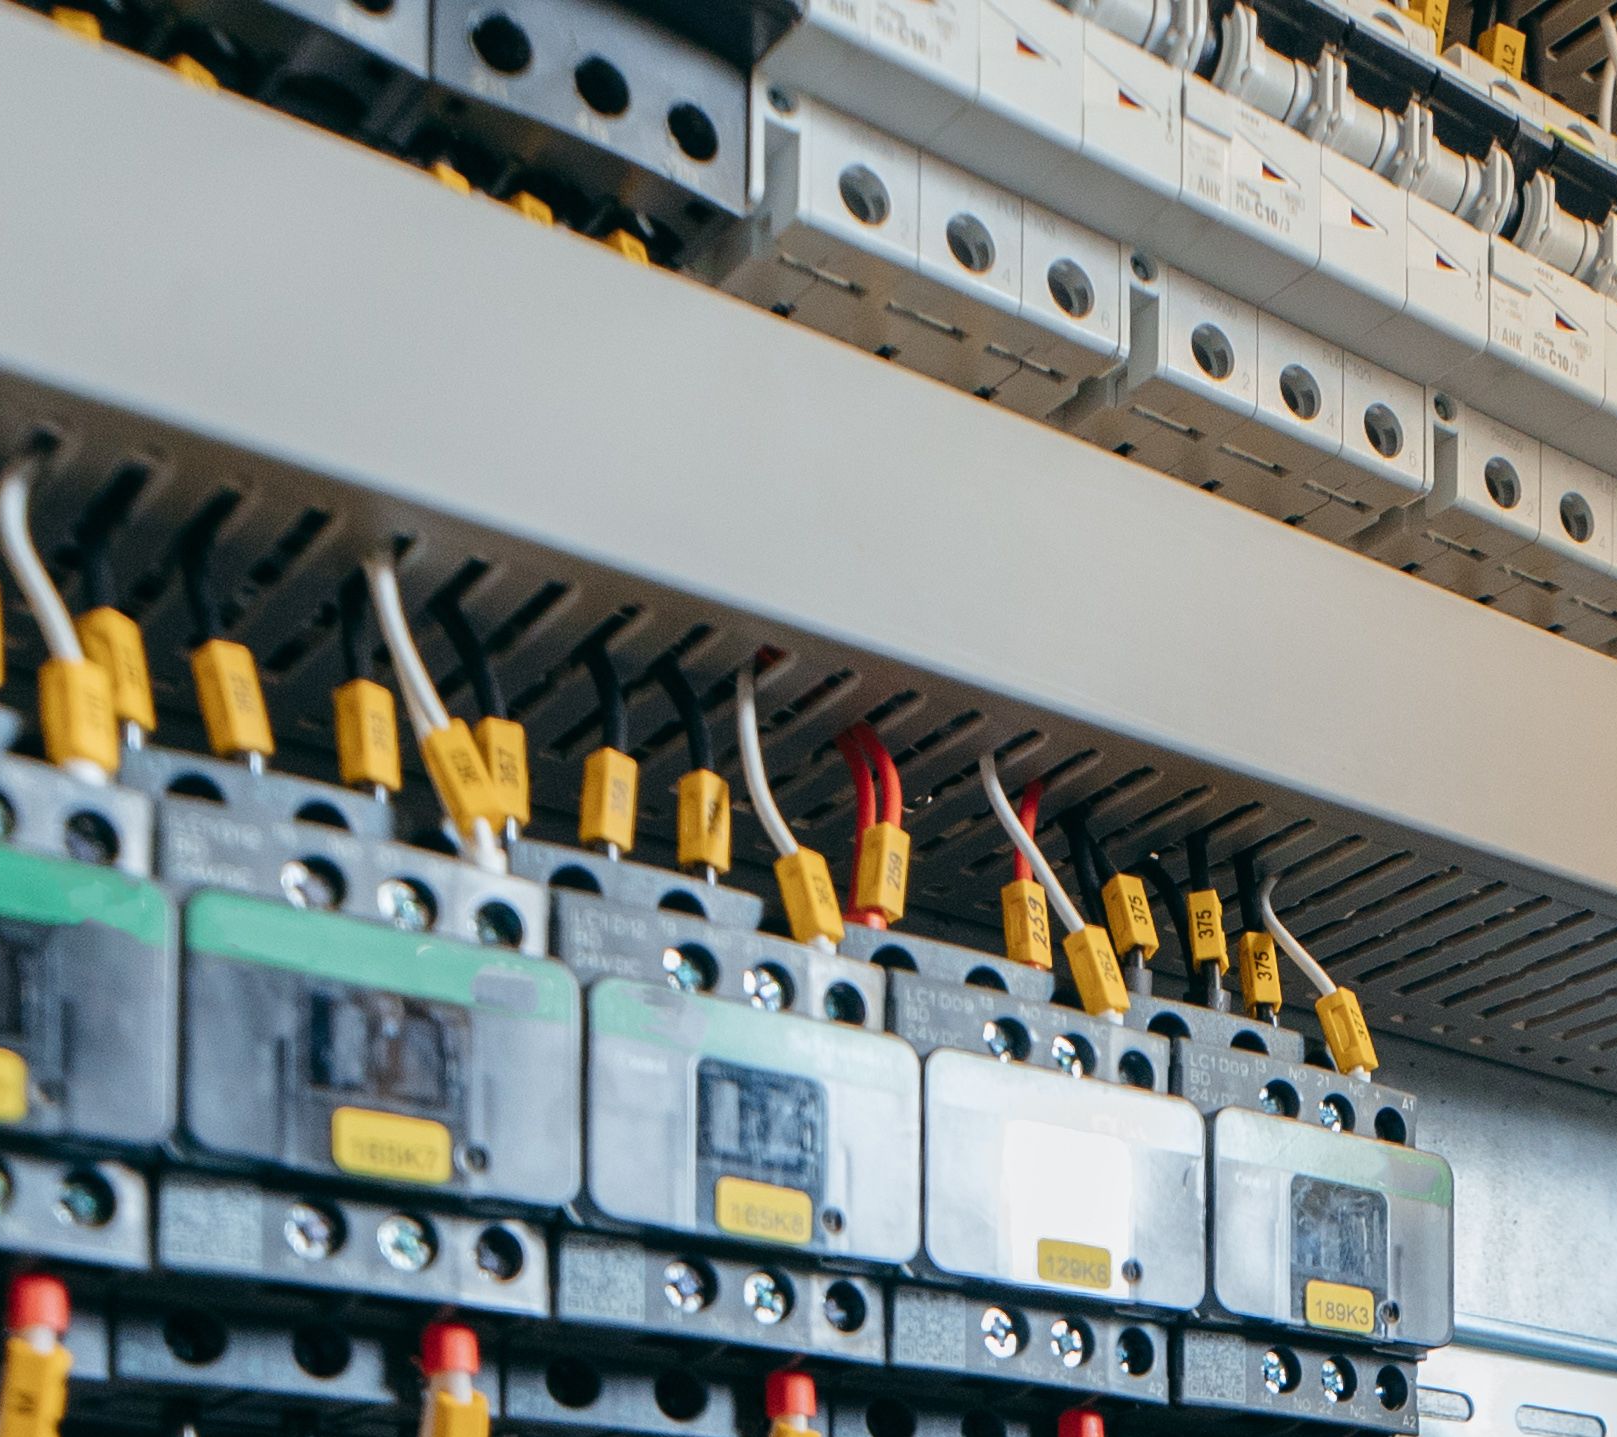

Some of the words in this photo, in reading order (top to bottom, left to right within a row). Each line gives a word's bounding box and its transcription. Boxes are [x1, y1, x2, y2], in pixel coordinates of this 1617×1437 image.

[885, 850, 904, 892] 259
[1032, 895, 1050, 949] 259
[1127, 893, 1148, 926] 375
[1196, 908, 1214, 940] 375
[1103, 948, 1120, 983] 262
[1255, 950, 1273, 982] 375
[1188, 1052, 1250, 1079] LC1D09
[1253, 1057, 1268, 1073] 13
[1287, 1065, 1308, 1082] NO
[1316, 1074, 1331, 1088] 21
[1189, 1069, 1212, 1087] BD
[1400, 1097, 1415, 1113] A1
[1042, 1255, 1108, 1286] 129K6
[1314, 1296, 1371, 1327] 189K3
[1292, 1395, 1312, 1412] NO
[1318, 1400, 1335, 1416] 22
[1401, 1414, 1418, 1430] A2
